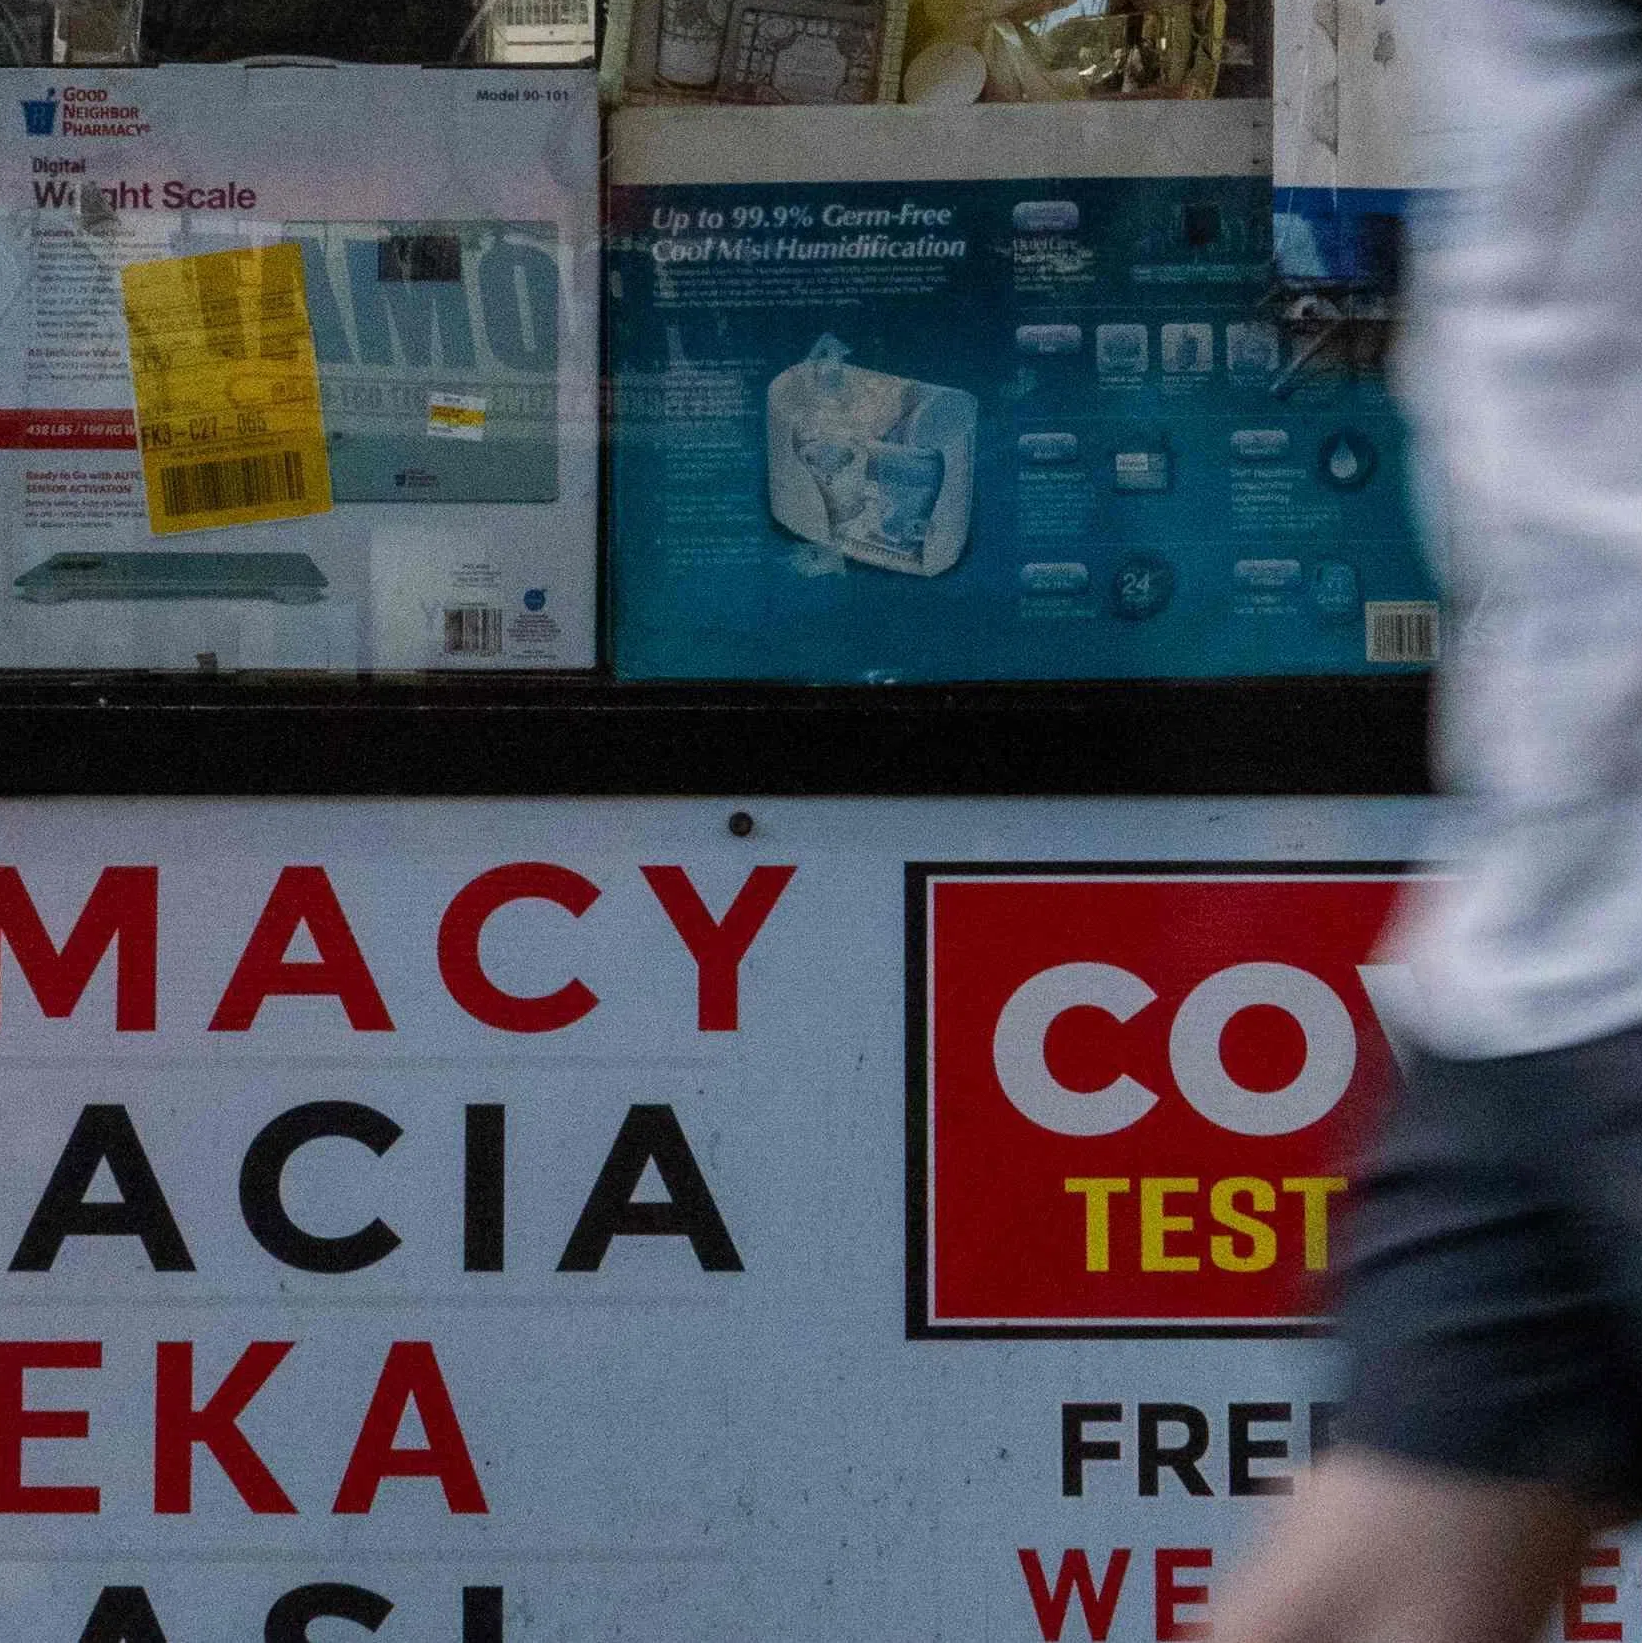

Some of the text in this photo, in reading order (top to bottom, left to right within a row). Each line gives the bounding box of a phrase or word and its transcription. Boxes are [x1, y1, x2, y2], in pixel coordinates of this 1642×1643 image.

[63, 87, 108, 103] GOOD
[476, 89, 570, 103] Model 90-101
[63, 105, 140, 121] NEIGHBOR
[32, 158, 86, 176] Digital
[162, 180, 257, 209] Scale
[652, 206, 690, 236] Up
[698, 208, 723, 229] to
[732, 205, 814, 229] 99.9%
[652, 235, 966, 263] Cool Mist Humidification
[26, 470, 58, 482] Ready
[1122, 573, 1151, 595] 24
[1062, 1174, 1351, 1274] TEST
[1059, 1402, 1341, 1499] FRE
[1017, 1547, 1213, 1643] WE
